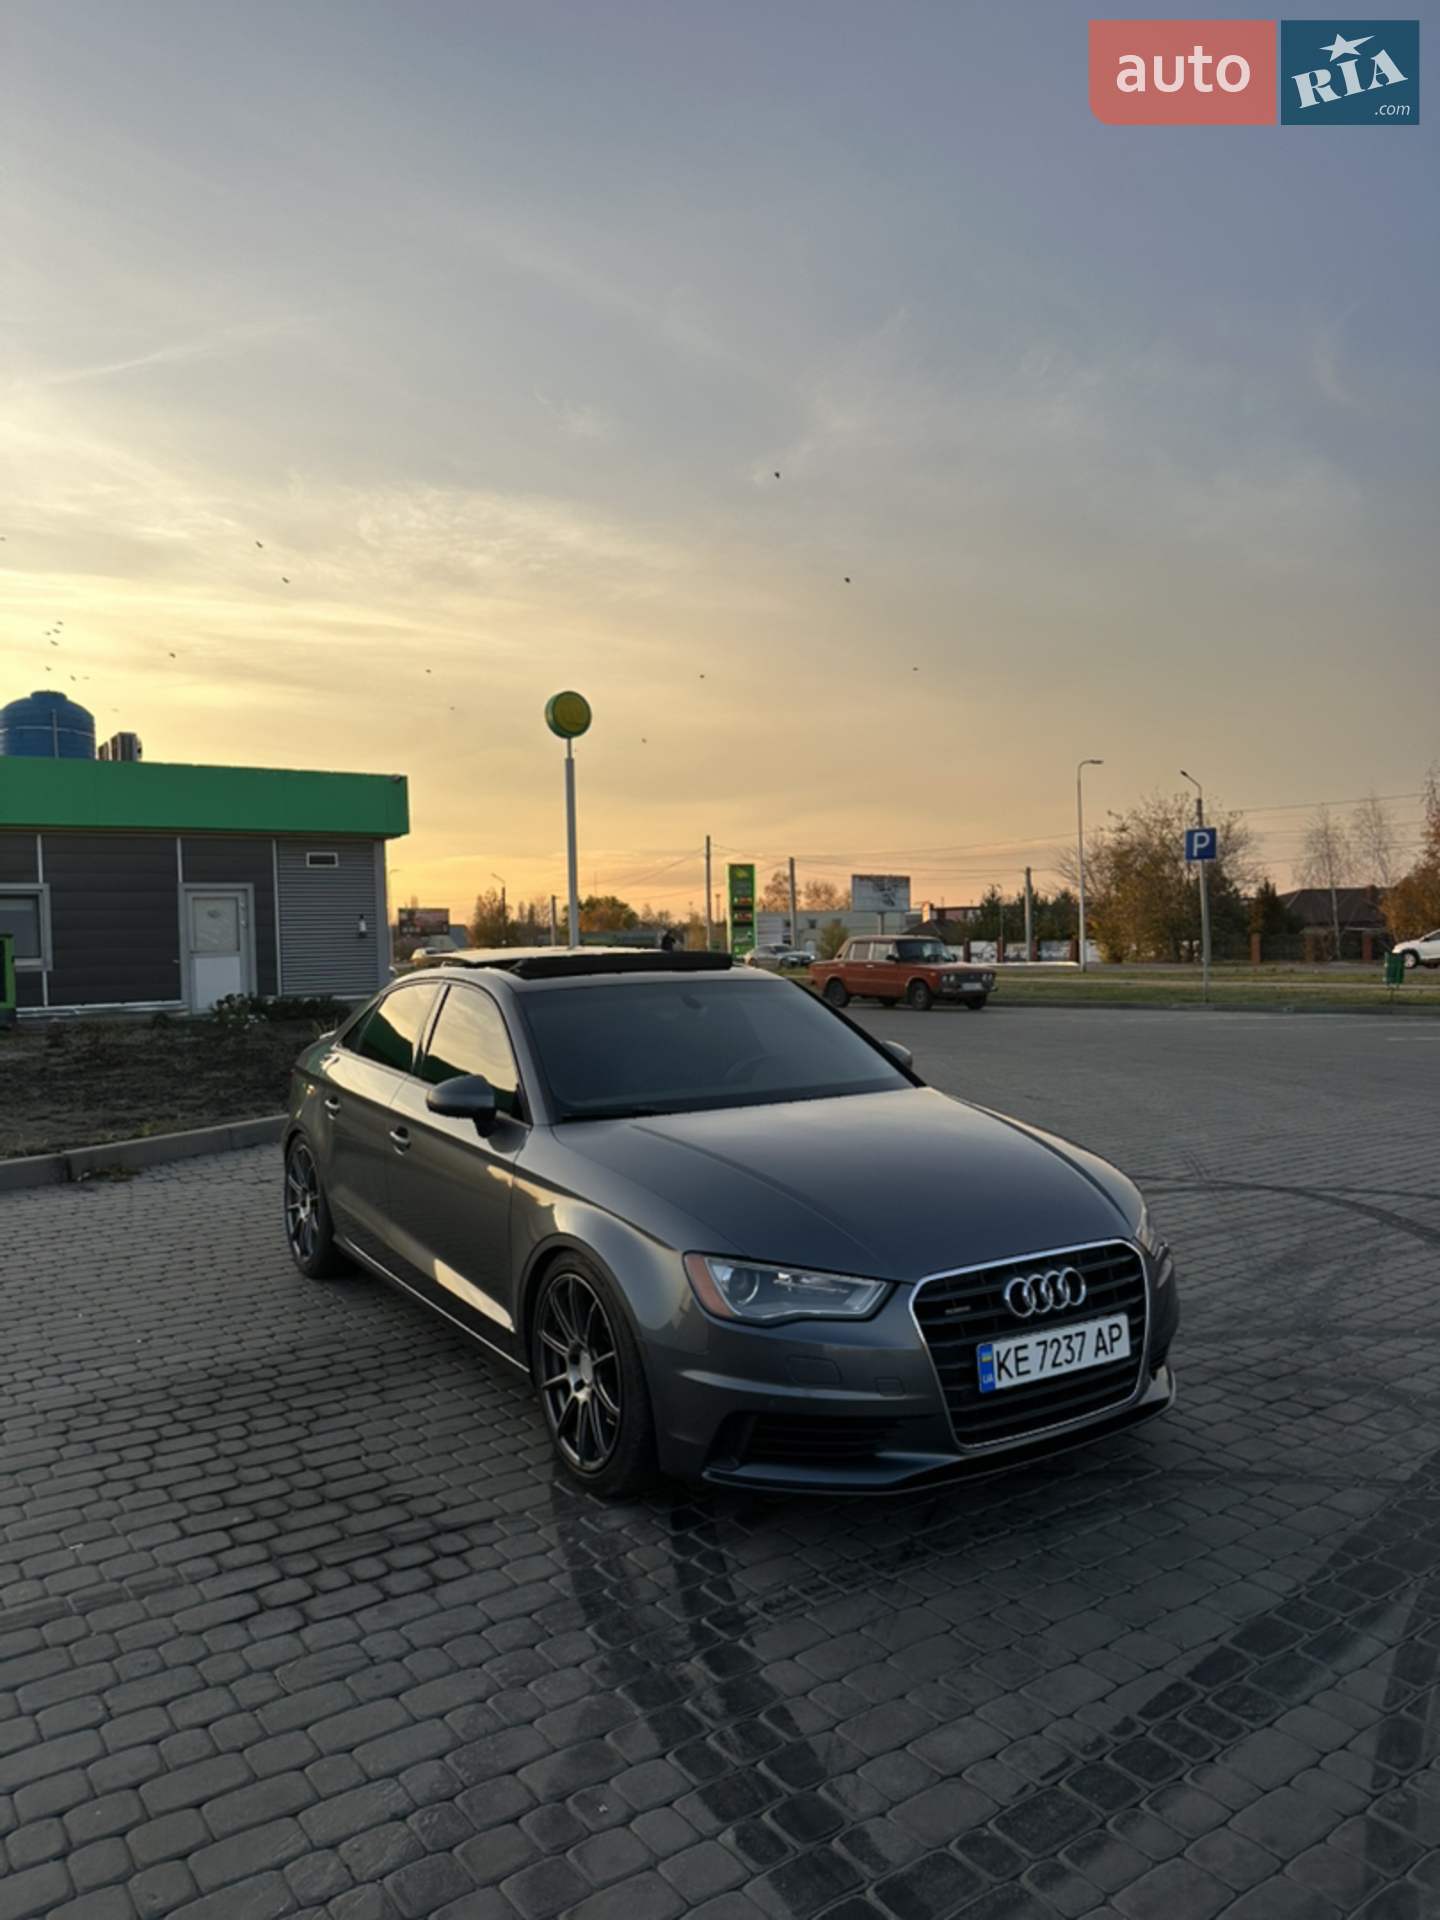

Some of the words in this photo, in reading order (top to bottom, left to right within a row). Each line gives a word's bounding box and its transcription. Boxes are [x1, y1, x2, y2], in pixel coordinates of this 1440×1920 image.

[1193, 832, 1210, 857] P
[996, 1344, 1031, 1382] KE
[1036, 1331, 1086, 1372] 7237
[1094, 1323, 1123, 1358] AP
